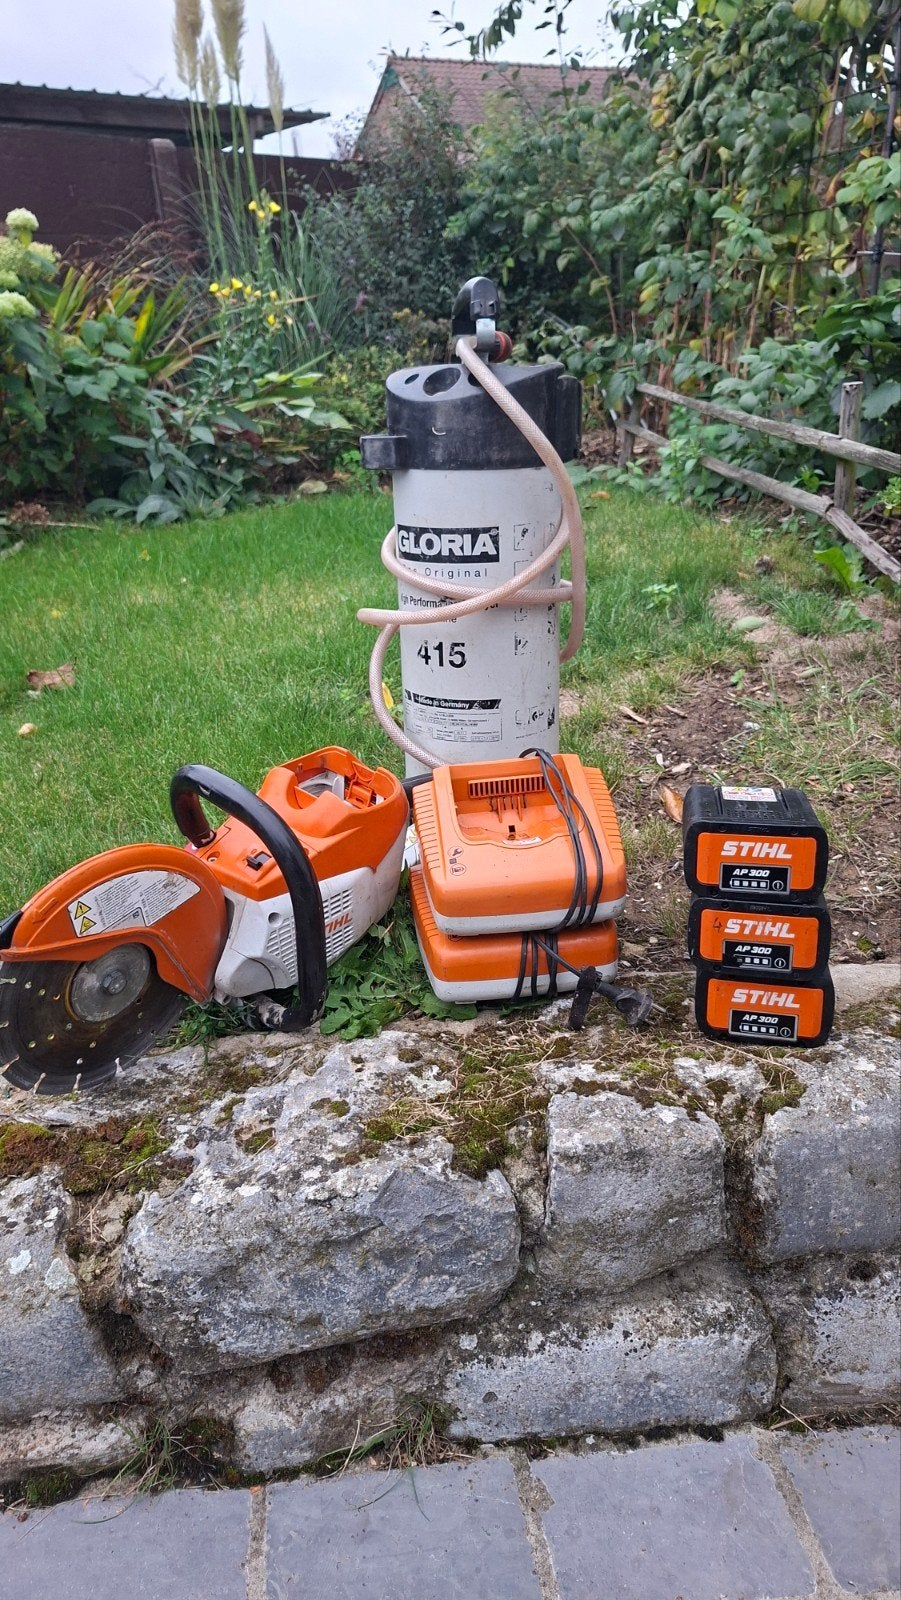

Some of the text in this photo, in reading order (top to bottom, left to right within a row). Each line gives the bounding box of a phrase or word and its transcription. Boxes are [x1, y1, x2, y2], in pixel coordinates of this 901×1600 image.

[398, 529, 498, 556] GLORIA
[424, 567, 488, 579] Original
[416, 640, 467, 668] 415
[440, 699, 470, 709] Germany
[721, 840, 793, 859] STIHL
[732, 868, 770, 877] AP 300
[724, 918, 796, 938] STIHL
[735, 945, 772, 954] AP 300
[731, 988, 801, 1008] STIHL
[742, 1014, 779, 1024] AP 300
